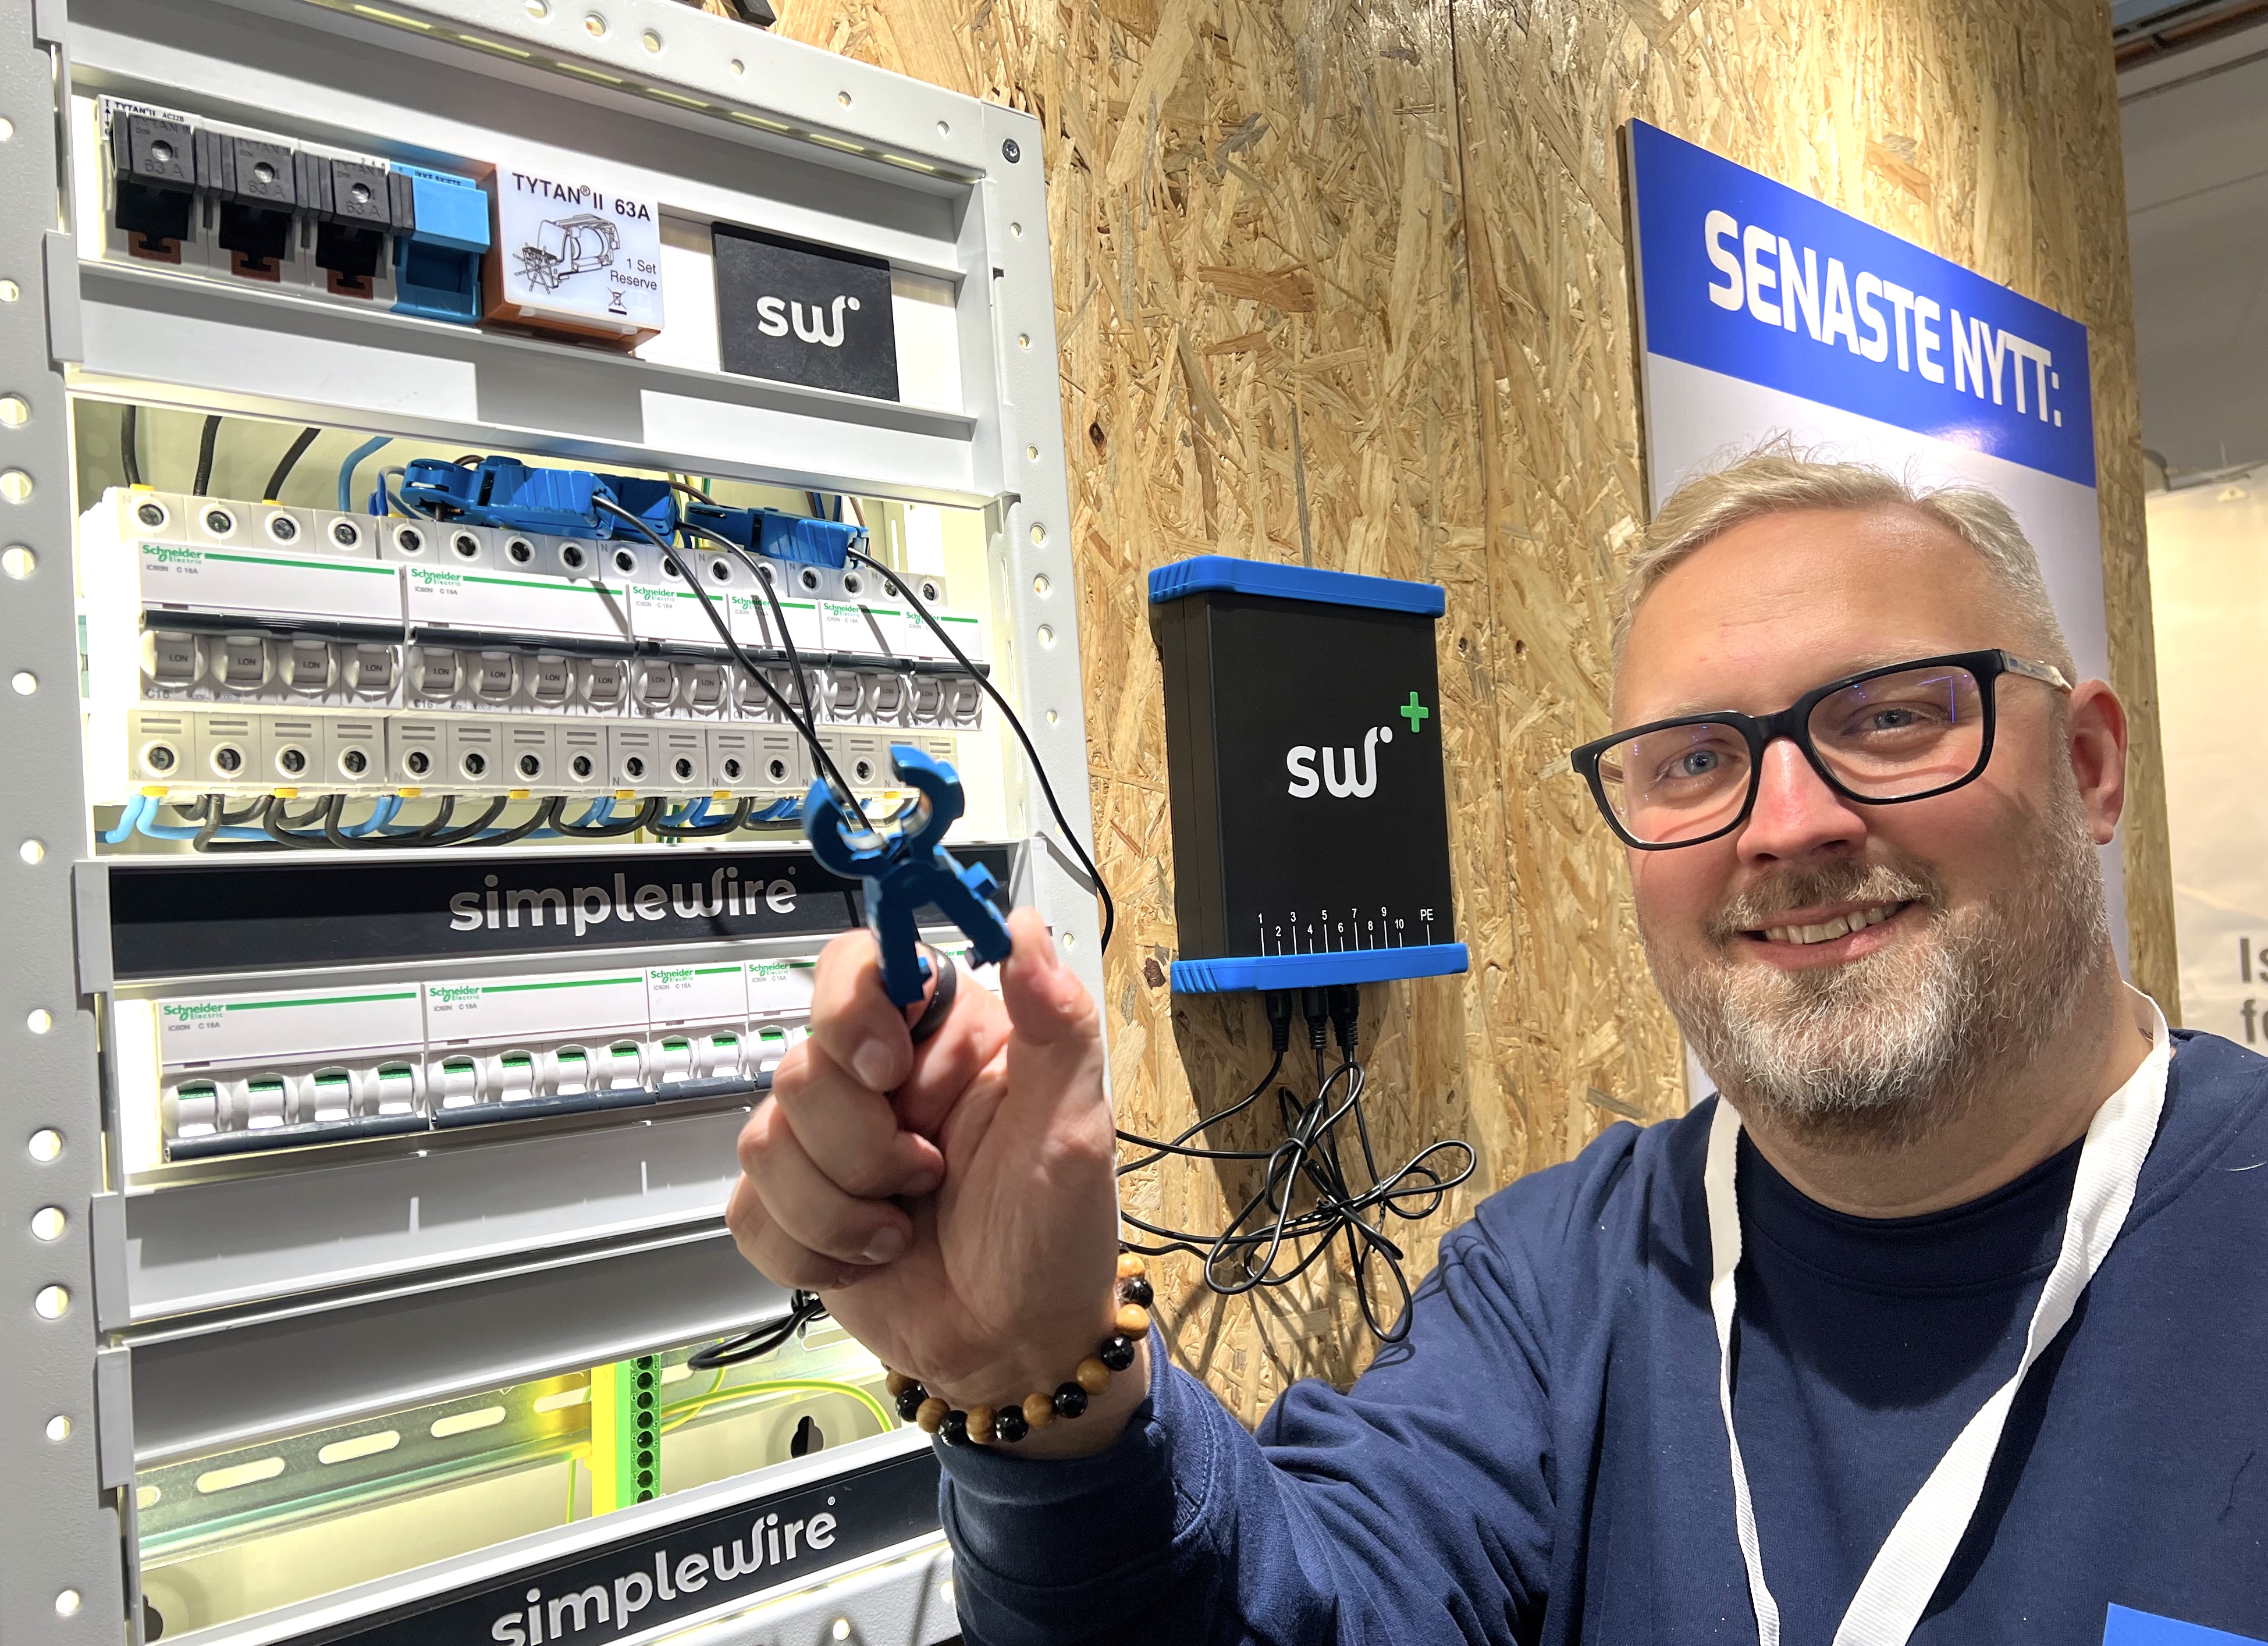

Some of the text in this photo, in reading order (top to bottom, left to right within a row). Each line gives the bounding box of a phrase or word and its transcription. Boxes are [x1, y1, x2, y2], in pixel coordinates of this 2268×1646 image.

[145, 159, 184, 179] 63 A
[248, 180, 286, 199] 63 A
[346, 201, 381, 219] 63 A
[592, 192, 603, 210] II
[615, 198, 651, 222] 63A
[627, 258, 657, 274] 1 Set
[610, 270, 658, 290] Reserve
[1705, 209, 2062, 428] SENASTE NYTT:
[142, 545, 202, 561] Schneider
[600, 544, 608, 552] N
[699, 554, 705, 562] N
[411, 568, 461, 582] Schneider
[872, 572, 878, 580] N
[632, 586, 675, 598] Schneider
[823, 603, 860, 613] Schneider
[613, 777, 620, 785] N
[712, 778, 719, 786] N
[885, 780, 891, 788] N
[1290, 911, 1296, 922] 3
[1321, 909, 1328, 920] 5
[1352, 908, 1357, 919] 7
[1381, 906, 1387, 917] 9
[1420, 909, 1434, 922] PE
[1258, 913, 1263, 924] 1
[1395, 918, 1405, 929] 10
[1307, 924, 1313, 935] 4
[1338, 922, 1344, 933] 6
[1367, 920, 1374, 931] 8
[1275, 926, 1281, 937] 2
[749, 962, 790, 973] Schneider
[650, 968, 694, 980] Schneider
[429, 986, 480, 998] Schneider
[163, 1002, 224, 1017] Schneider
[631, 1373, 637, 1382] 5
[653, 1381, 658, 1390] 8
[631, 1392, 637, 1402] 6
[631, 1412, 637, 1421] 7
[631, 1432, 637, 1441] 8
[631, 1452, 637, 1461] 9
